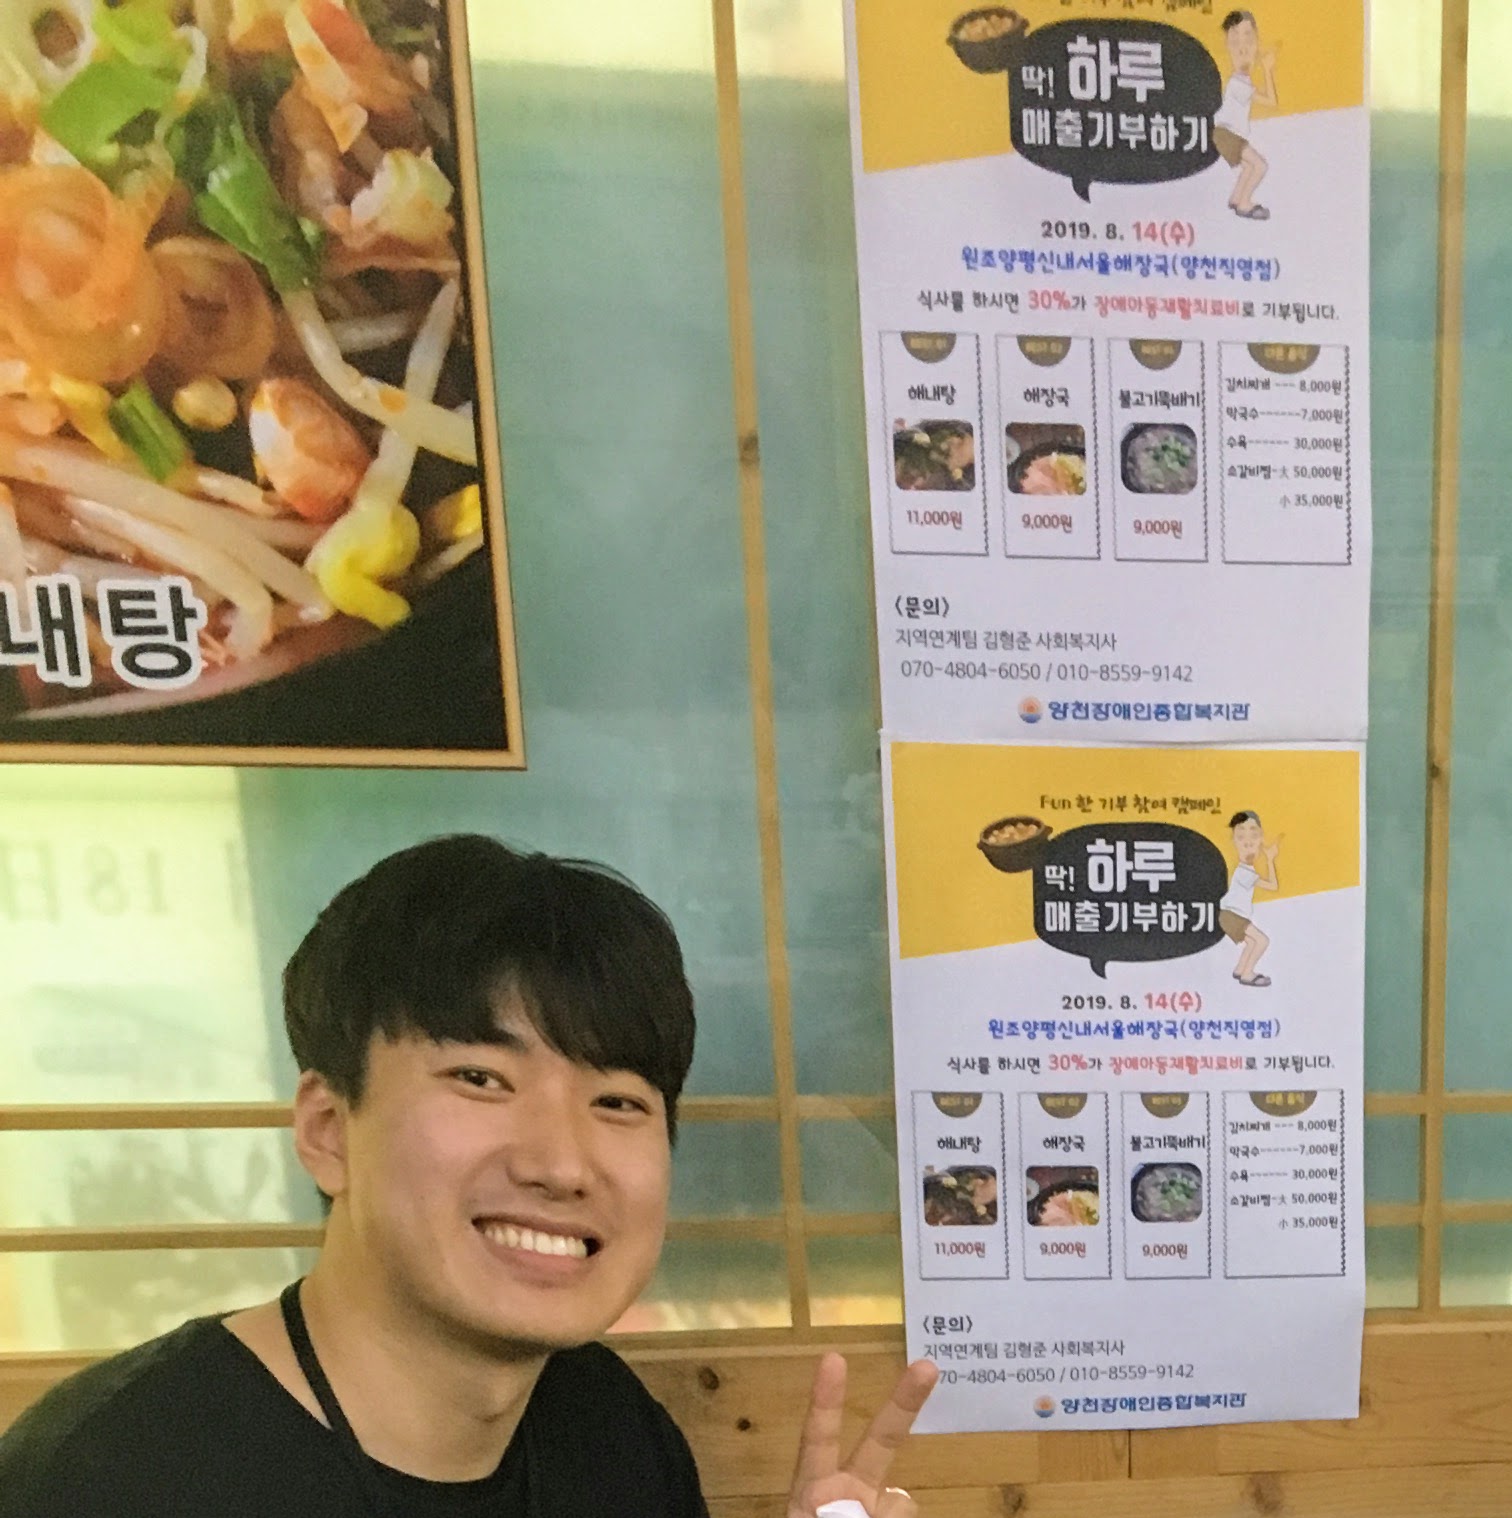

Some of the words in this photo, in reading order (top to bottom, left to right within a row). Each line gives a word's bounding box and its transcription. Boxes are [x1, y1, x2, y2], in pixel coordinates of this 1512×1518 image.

[1021, 64, 1055, 98] 딱!
[1066, 36, 1166, 102] 하루
[1021, 108, 1209, 153] 매출기부하기
[1041, 221, 1098, 240] 2019.
[1105, 222, 1125, 240] 8.
[1132, 221, 1196, 248] 14(수)
[917, 289, 965, 312] 식사를
[972, 290, 1019, 312] 하시면
[1027, 289, 1087, 313] 30%가
[907, 384, 957, 406] 해내탕
[1023, 387, 1070, 408] 해장국
[1301, 409, 1344, 424] 7,000원
[1293, 465, 1343, 481] 50,000원
[905, 508, 963, 531] 11,000원
[1021, 512, 1073, 534] 9,000원
[1132, 519, 1183, 540] 9,000원
[895, 627, 978, 650] 지역연계팀
[982, 631, 1033, 651] 김형준
[1035, 631, 1117, 652] 사회복지사
[900, 659, 1041, 682] 070-4804-6050
[1056, 661, 1194, 683] 010-8559-9142
[1047, 700, 1251, 722] 양천장애인종합복지관
[1040, 794, 1072, 810] Fun
[1098, 795, 1128, 812] 기부
[1044, 865, 1076, 892] 딱!
[1086, 838, 1177, 893] 하루
[1044, 900, 1215, 933] 매출기부하기
[1061, 994, 1112, 1011] 2019.
[1119, 994, 1137, 1011] 8.
[1143, 992, 1203, 1014] 14(수)
[987, 1018, 1282, 1040] 원조양평신내서울해장국(양천직영점)
[947, 1056, 991, 1075] 식사를
[998, 1056, 1041, 1074] 하시면
[1047, 1053, 1103, 1072] 30%가
[1263, 1055, 1336, 1073] 기부됩니다.
[936, 1135, 983, 1153] 해내탕
[1042, 1135, 1086, 1152] 해장국
[933, 1242, 986, 1259] 11,000원
[1040, 1242, 1087, 1258] 9,000원
[1141, 1242, 1188, 1259] 9,000원
[923, 1342, 999, 1361] 지역연계팀
[1002, 1342, 1047, 1360] 김형준
[1051, 1339, 1125, 1358] 사회복지사
[938, 1367, 1056, 1385] 70-4804-6050
[1069, 1363, 1195, 1383] 010-8559-9142
